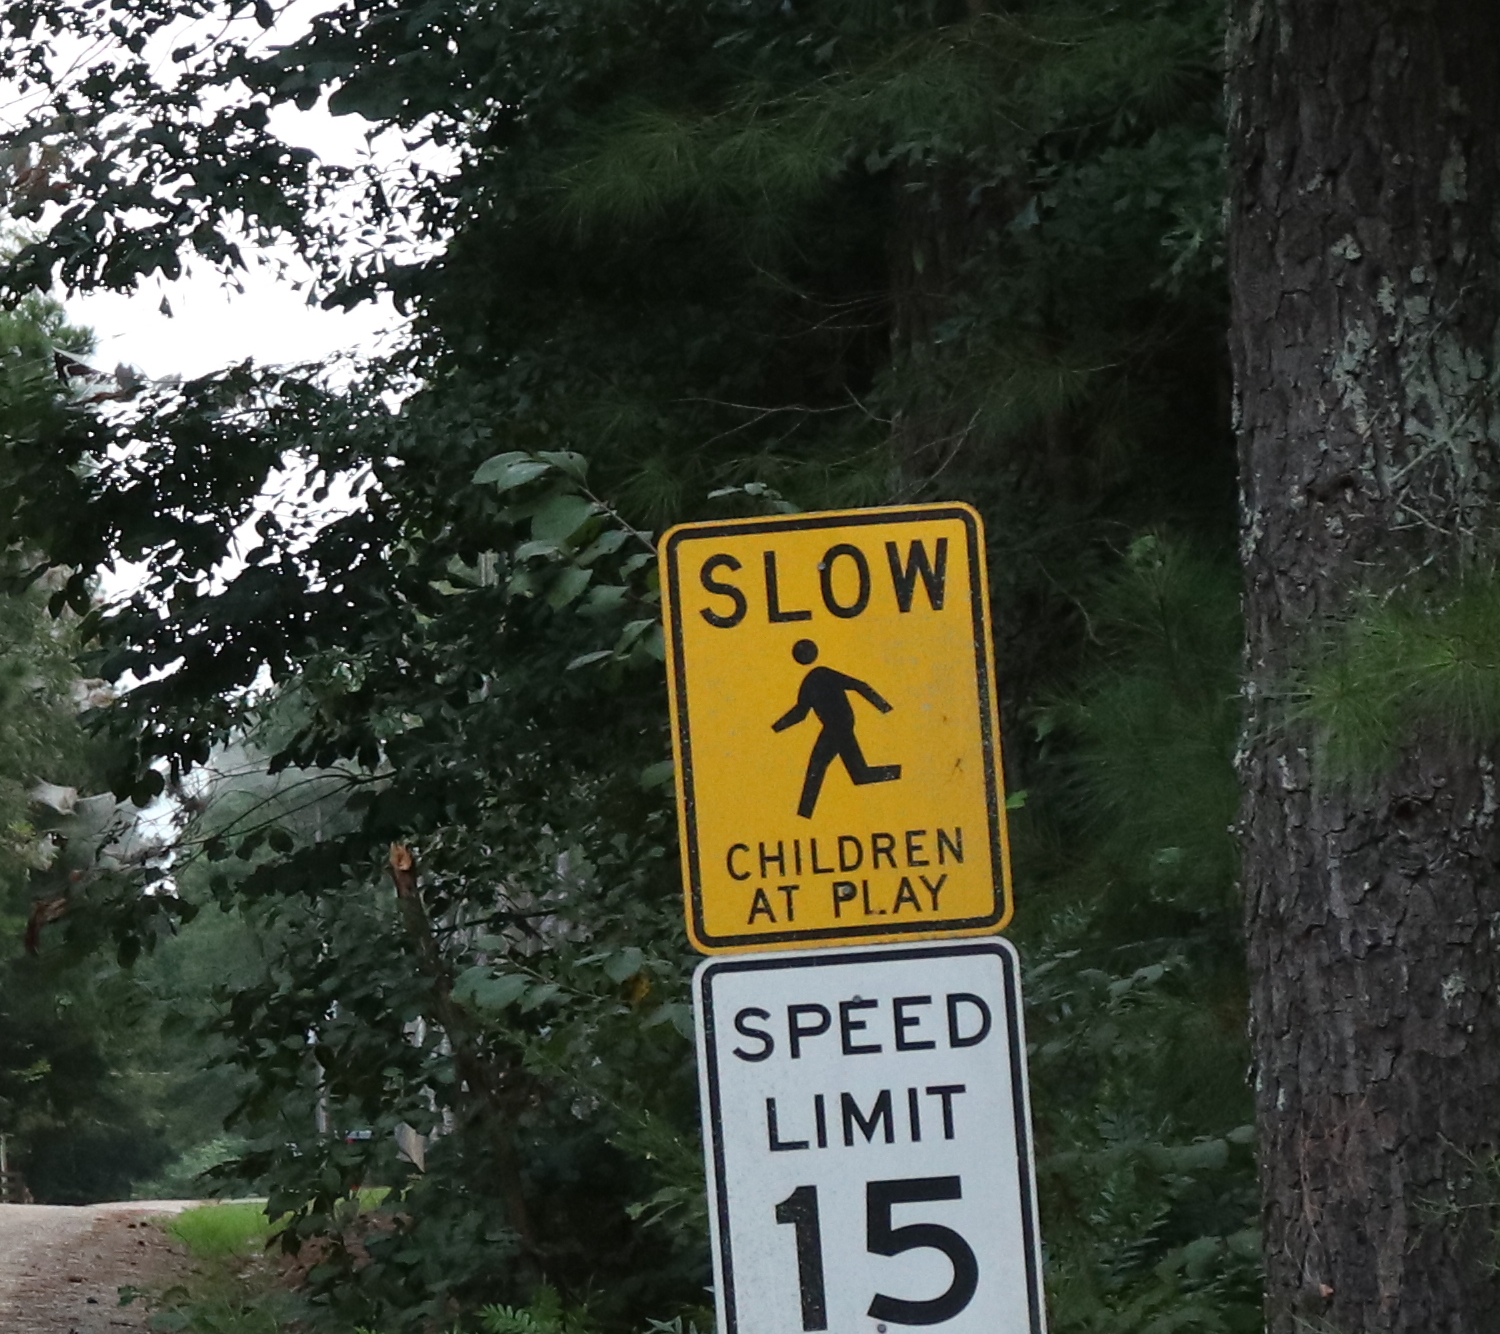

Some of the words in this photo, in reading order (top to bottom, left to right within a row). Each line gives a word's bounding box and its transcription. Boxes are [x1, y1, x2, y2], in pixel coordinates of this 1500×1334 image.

[699, 537, 948, 629] SLOW
[726, 827, 965, 882] CHILDREN
[747, 884, 800, 925] AT
[832, 874, 948, 918] PLAY
[732, 992, 993, 1063] SPEED
[765, 1084, 967, 1152] LIMIT
[775, 1175, 980, 1332] 15
